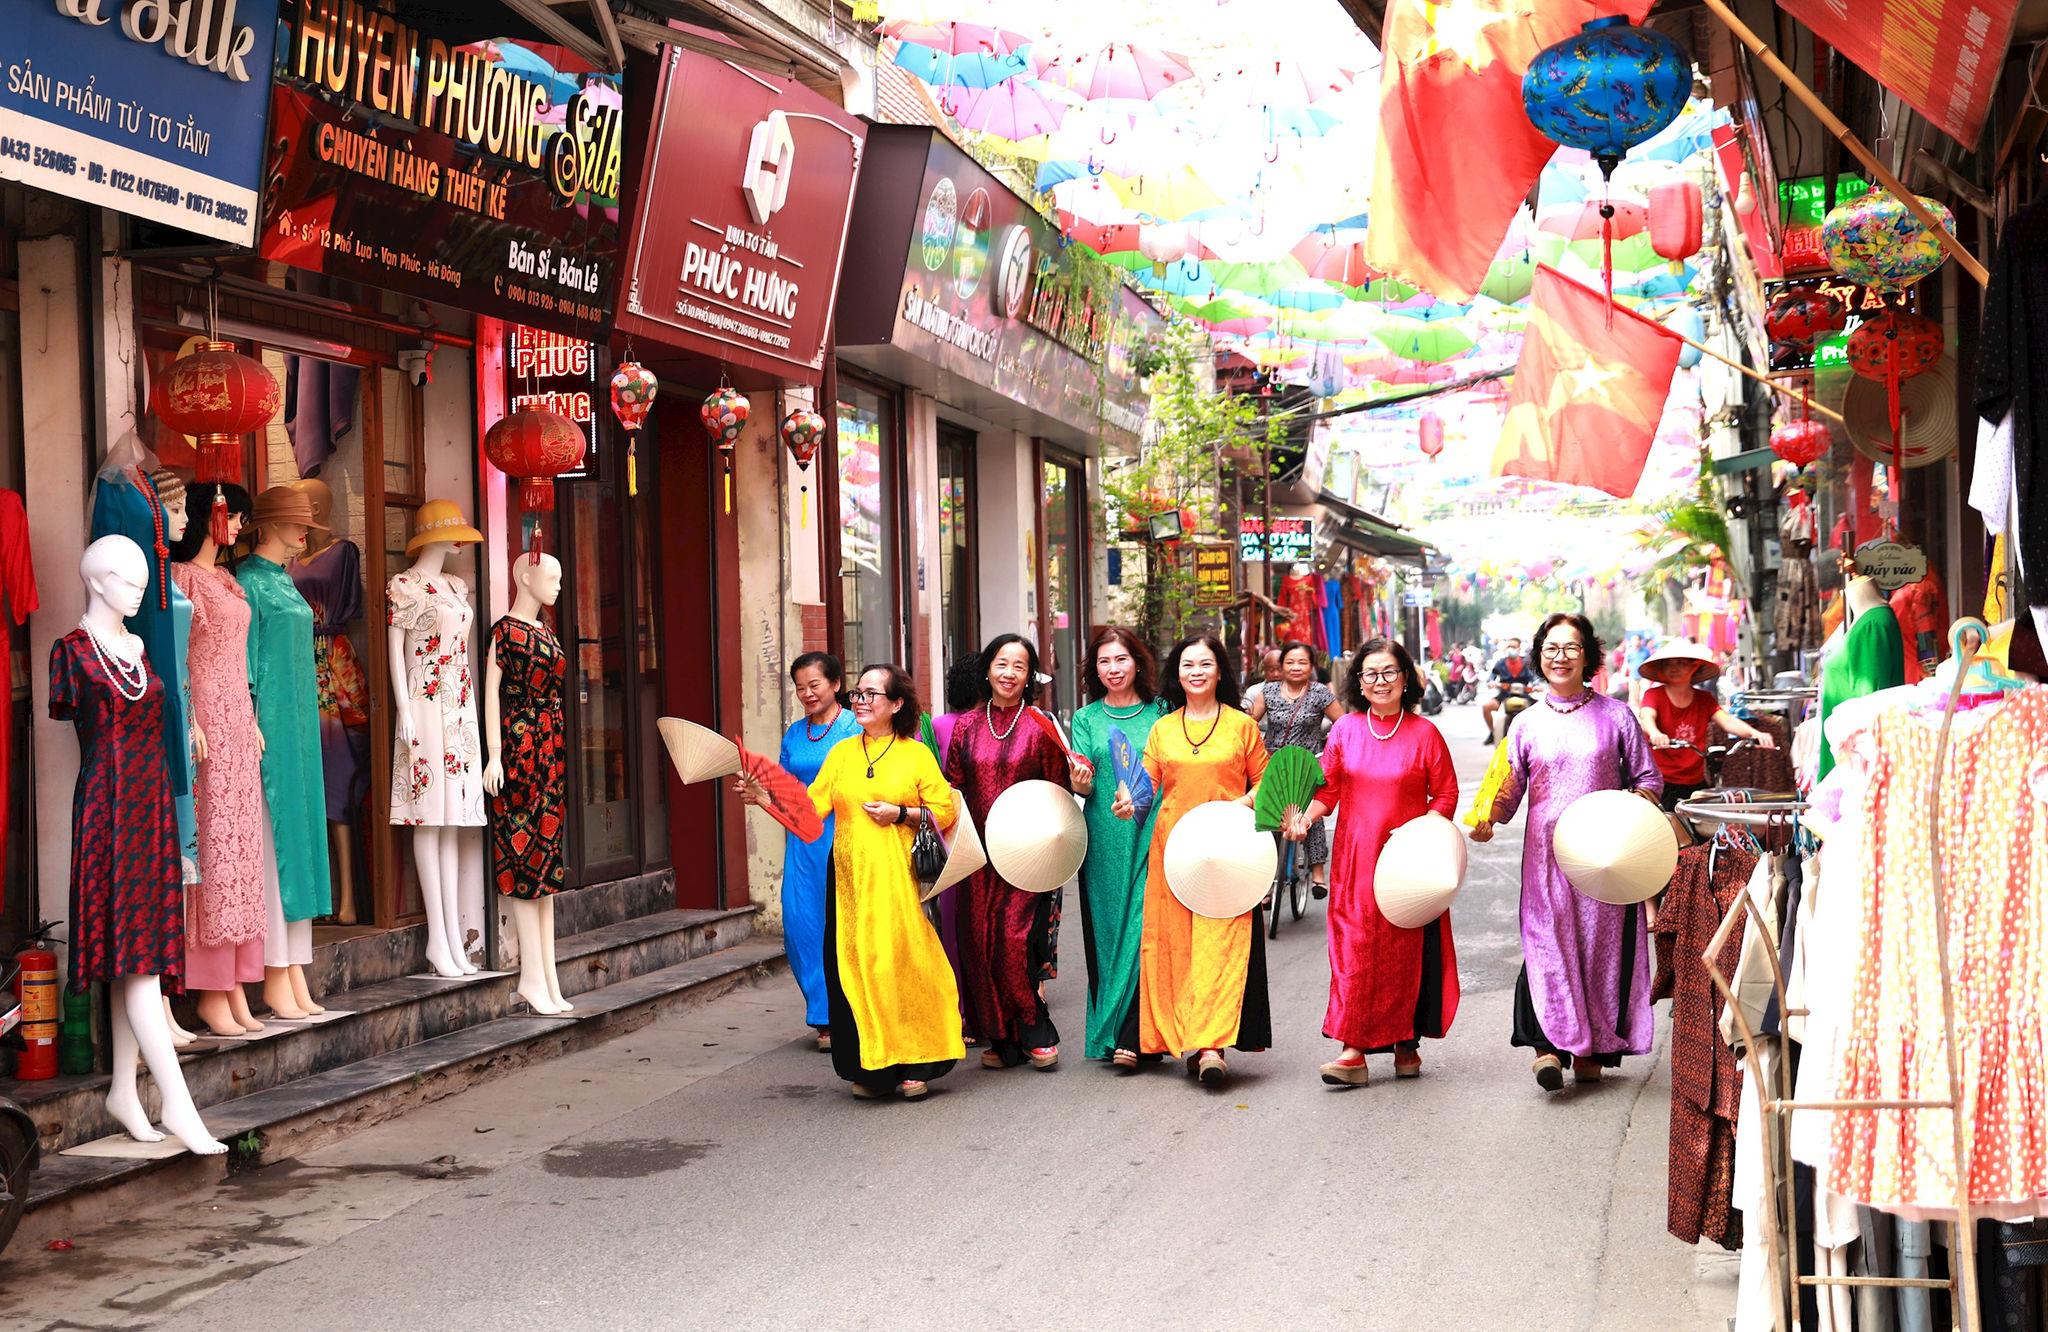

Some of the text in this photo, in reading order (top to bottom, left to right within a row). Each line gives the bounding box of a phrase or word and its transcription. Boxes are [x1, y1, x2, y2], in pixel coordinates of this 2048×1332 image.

[7, 59, 210, 157] SẢN PHẨM TỪ TƠ TẰM
[319, 122, 511, 221] CHUYÊN HÀNG THIẾT KẾ
[320, 229, 331, 248] 12
[334, 231, 353, 254] Phố
[356, 239, 372, 263] Lụa
[381, 246, 397, 270] Vạn
[400, 252, 421, 273] Phúc
[427, 258, 439, 279] Hà
[440, 264, 462, 289] Đông
[508, 240, 599, 294] Bán Sỉ Bán Lẻ
[680, 242, 799, 320] PHÚC HƯNG
